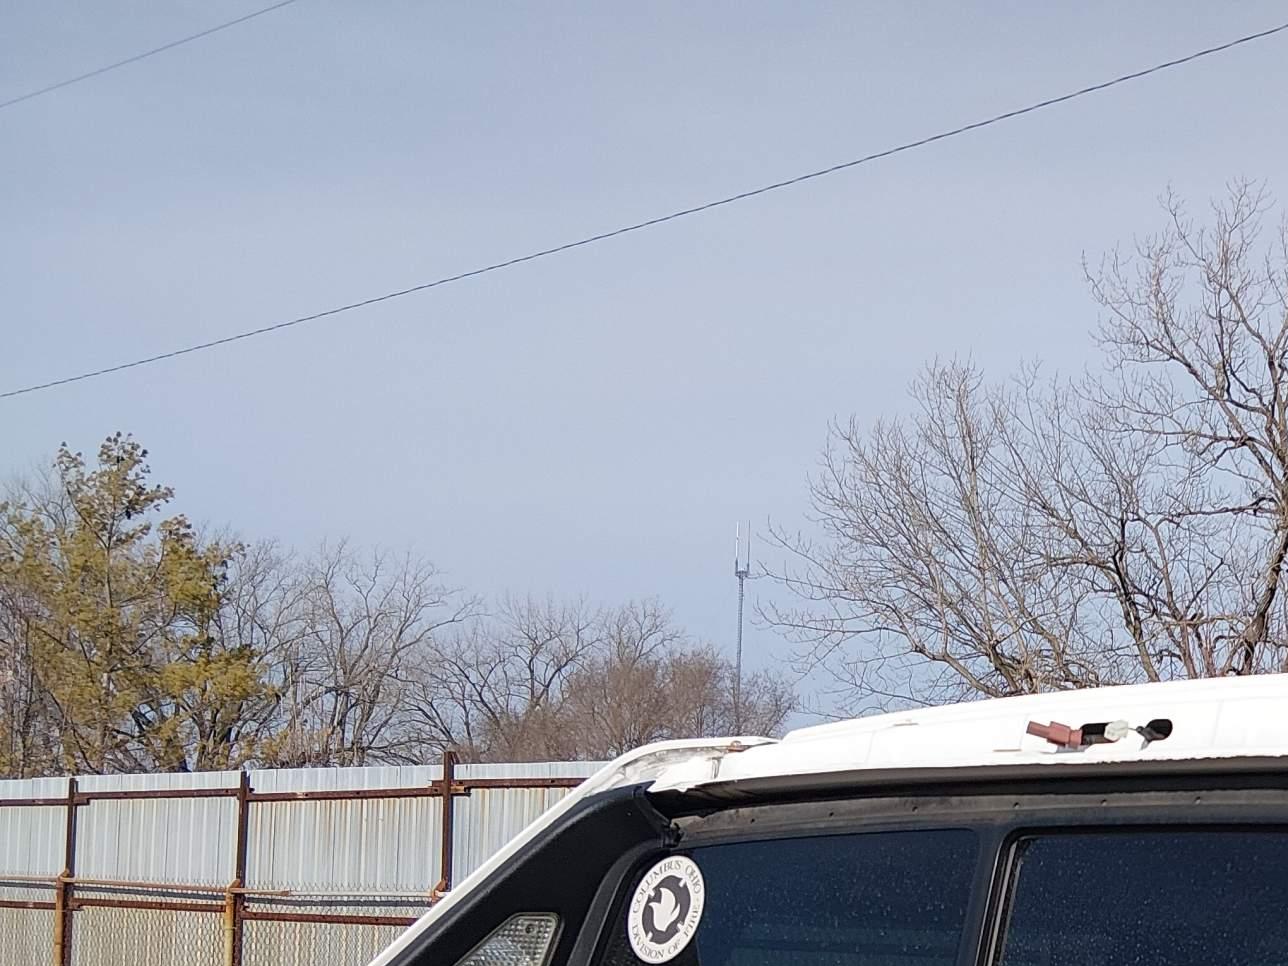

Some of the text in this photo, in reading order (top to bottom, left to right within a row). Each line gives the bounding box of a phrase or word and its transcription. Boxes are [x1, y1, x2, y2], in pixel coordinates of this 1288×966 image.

[632, 859, 702, 913] COLUMBUS OHIO
[631, 923, 665, 960] DIVISION
